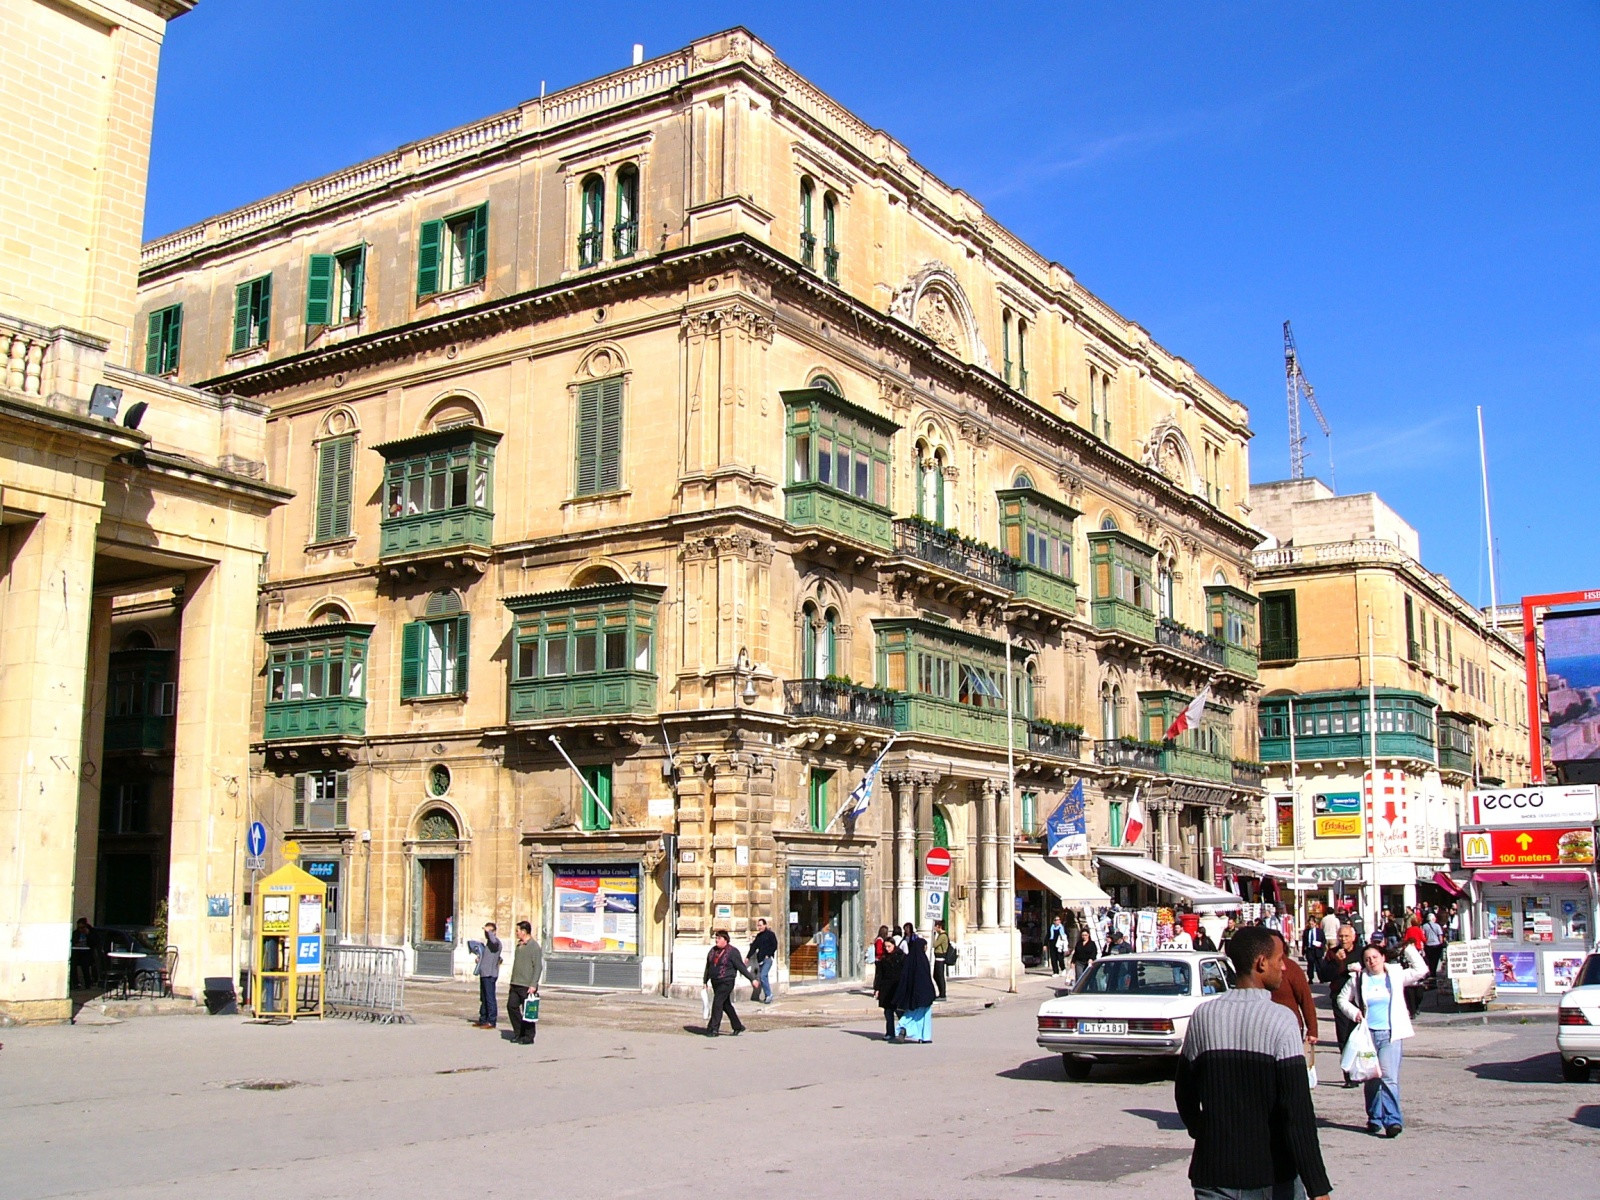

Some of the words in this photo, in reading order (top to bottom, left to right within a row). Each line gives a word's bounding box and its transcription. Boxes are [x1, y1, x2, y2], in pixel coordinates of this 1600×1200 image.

[1484, 793, 1543, 809] ecco
[1500, 854, 1516, 863] 100
[1518, 854, 1552, 862] meters
[300, 942, 318, 957] EF
